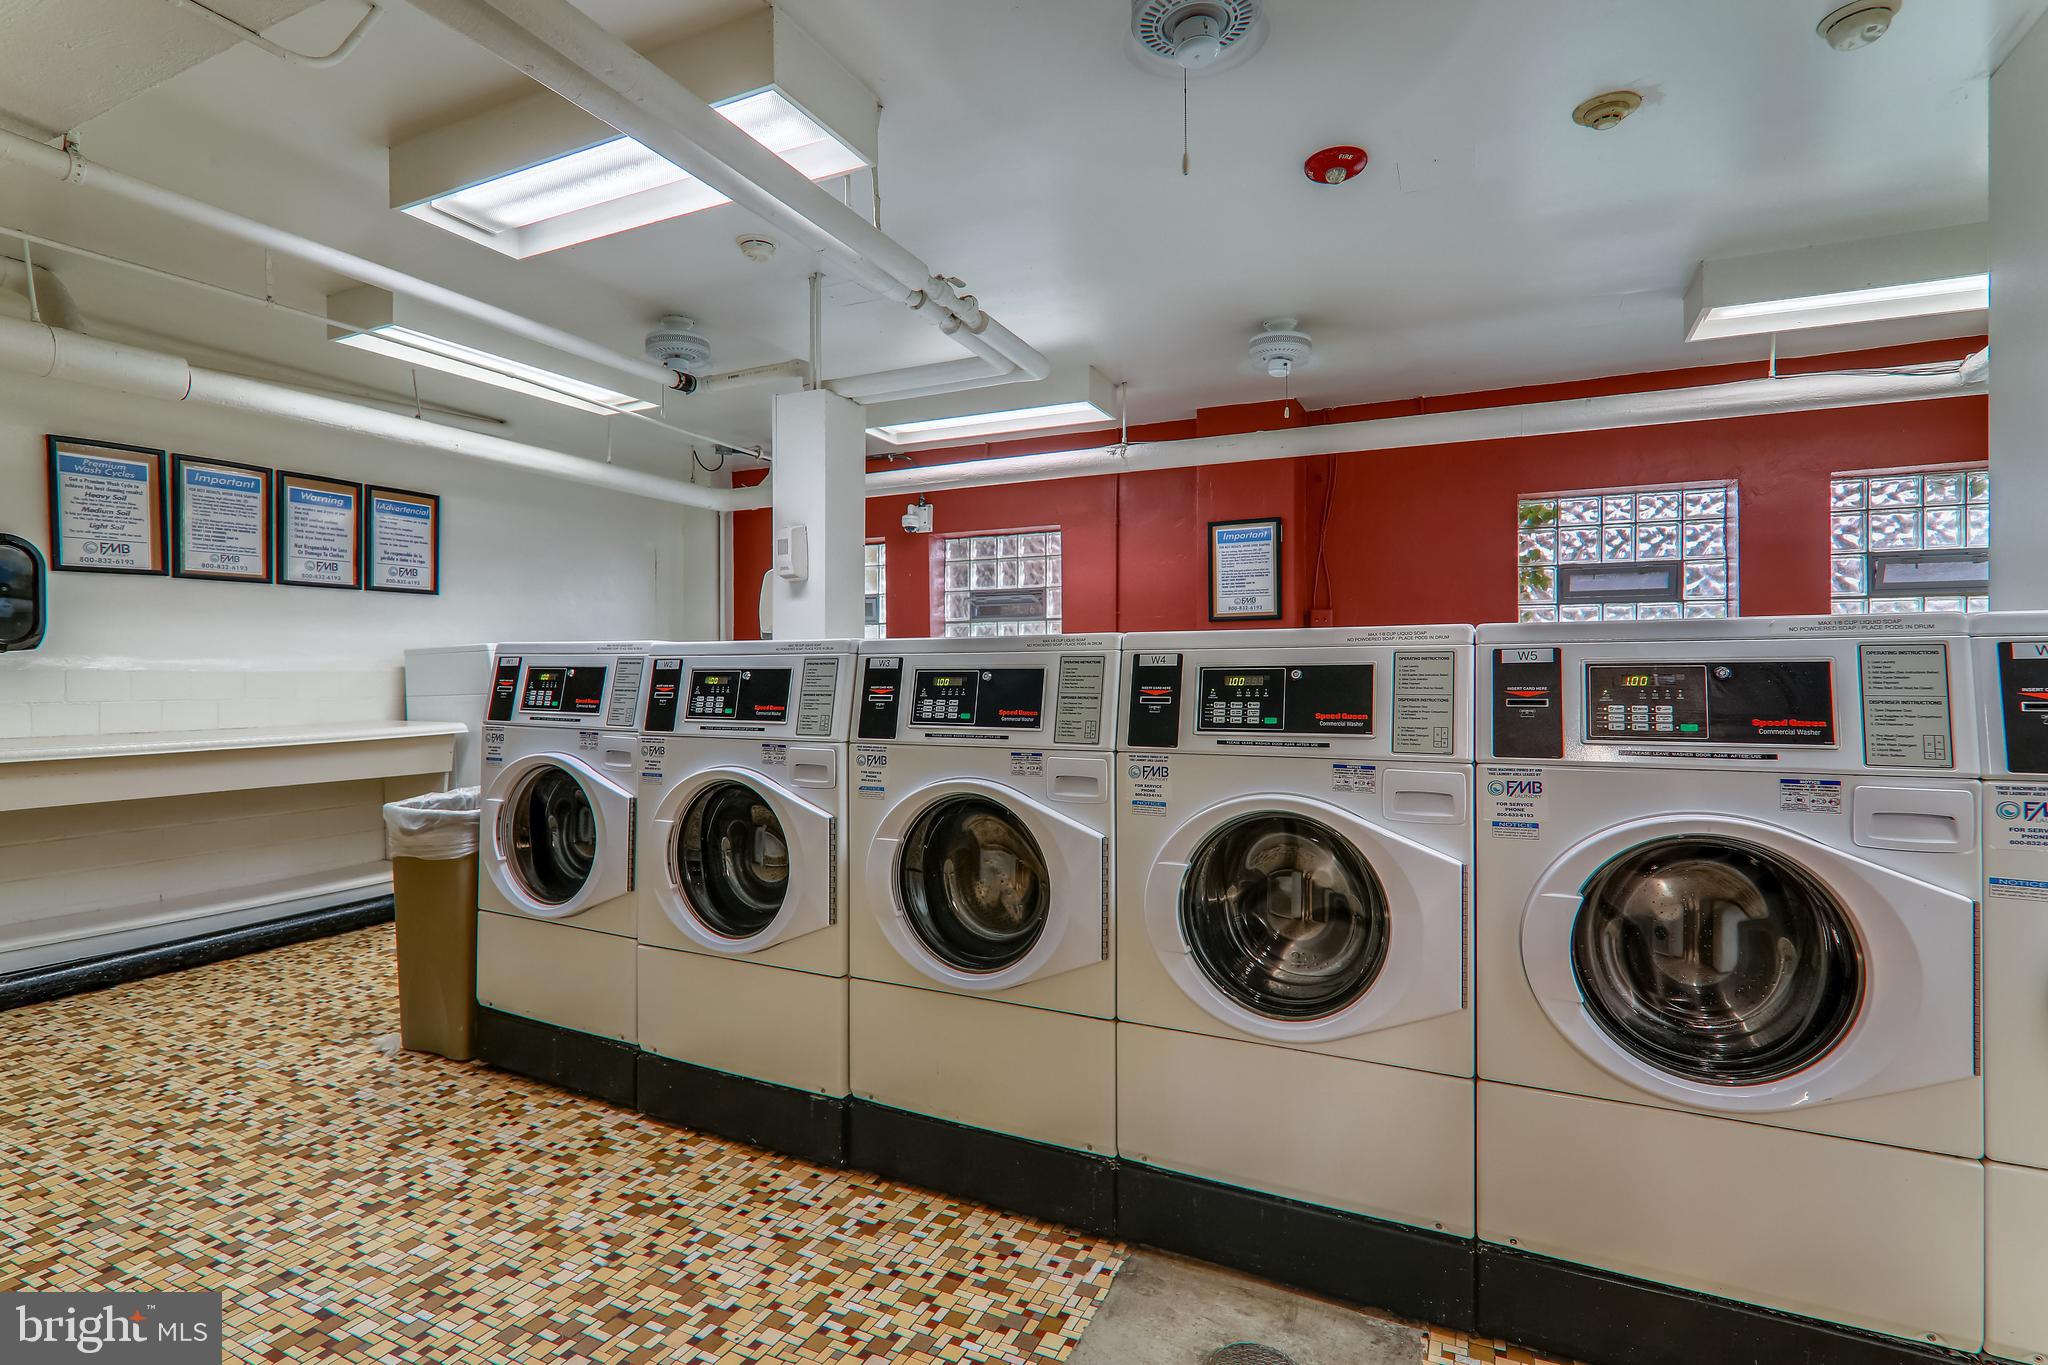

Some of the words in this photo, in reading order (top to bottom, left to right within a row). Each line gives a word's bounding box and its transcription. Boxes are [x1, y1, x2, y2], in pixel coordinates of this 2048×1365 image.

[82, 459, 126, 470] Premium
[74, 464, 101, 474] Wash
[105, 469, 135, 478] Cycles
[195, 472, 255, 488] Important
[85, 492, 110, 500] Heavy
[301, 492, 344, 506] Warning
[81, 506, 114, 515] Medium
[89, 522, 108, 530] Light
[1223, 531, 1267, 541] Important
[100, 542, 130, 555] FMB
[80, 557, 134, 565] 800-832-6193
[317, 562, 338, 572] FMB
[399, 568, 418, 577] FMB
[1151, 656, 1167, 664] W4
[1518, 651, 1538, 660] W5
[1752, 719, 1788, 727] Speed
[867, 755, 887, 767] FMB
[1142, 766, 1169, 779] FMB
[1506, 780, 1542, 797] FMB
